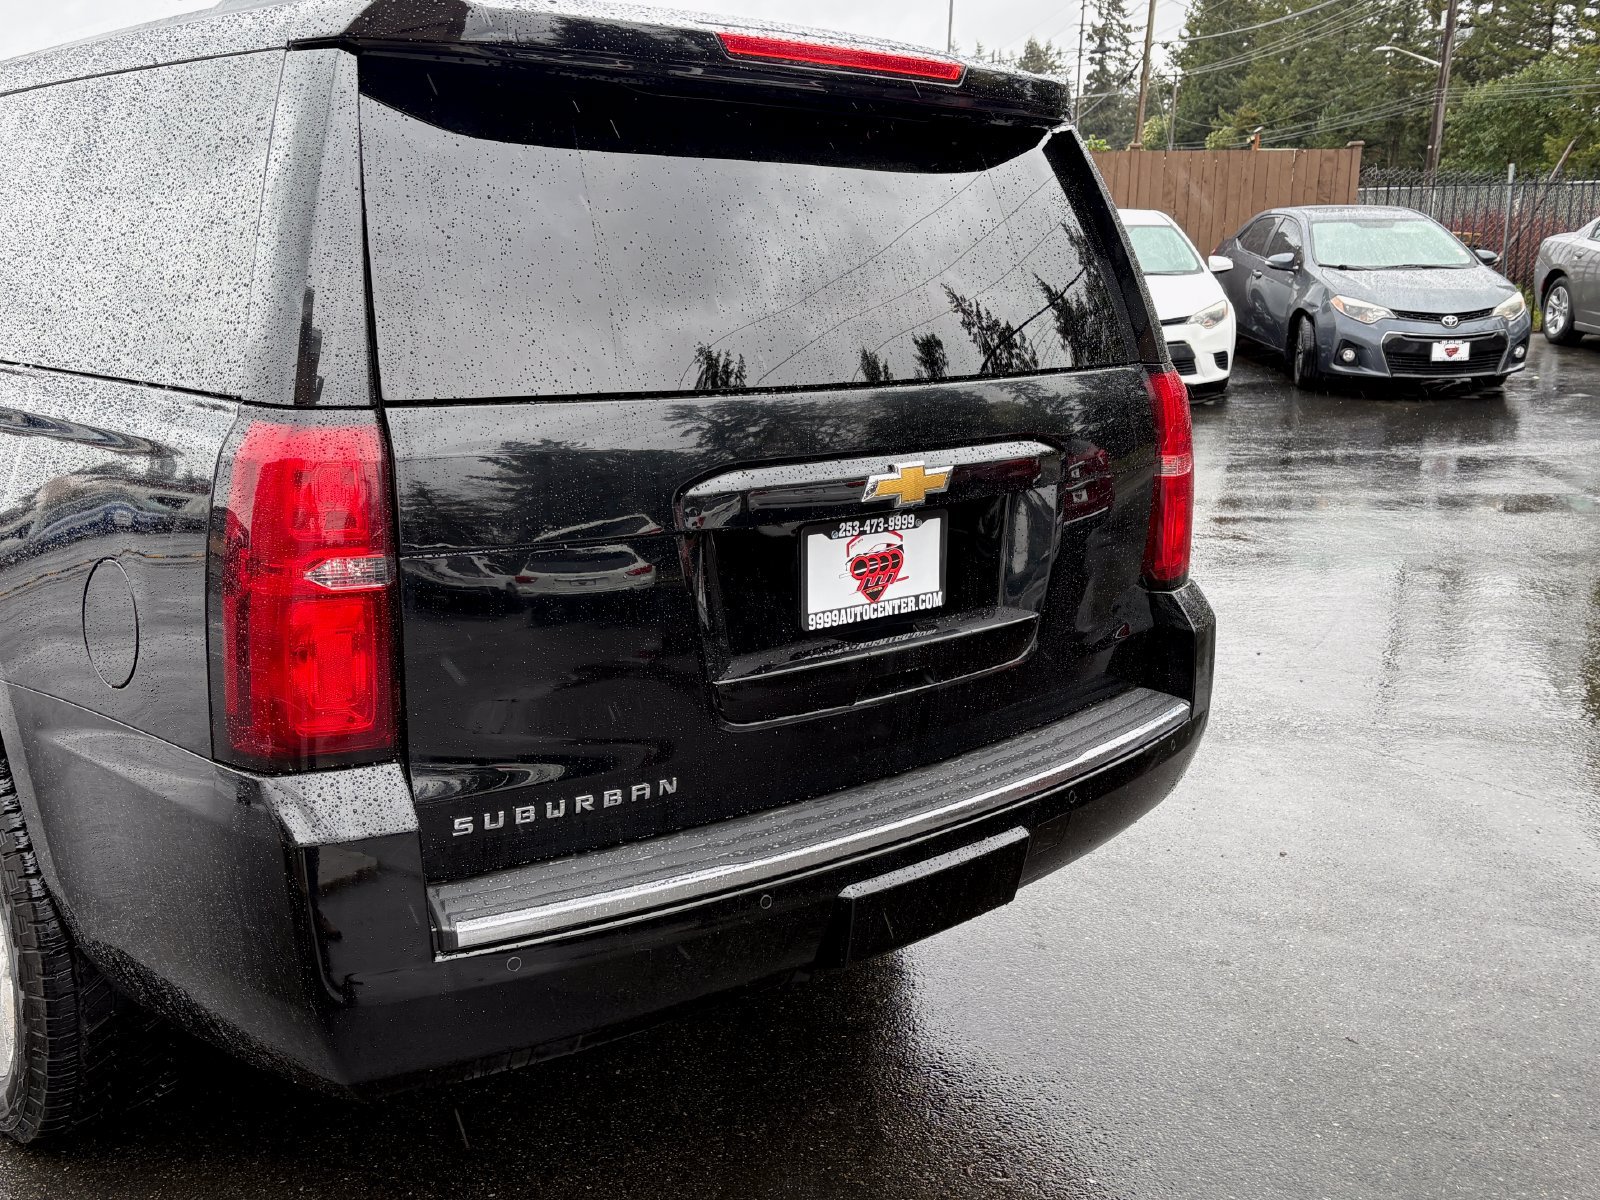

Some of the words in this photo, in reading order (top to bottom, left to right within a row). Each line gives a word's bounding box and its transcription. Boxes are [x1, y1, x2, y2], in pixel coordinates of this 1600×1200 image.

[838, 514, 915, 537] 253-473-9999
[808, 591, 943, 630] 9999AUTOCENTER.COM
[452, 777, 678, 836] SUBURBAN
